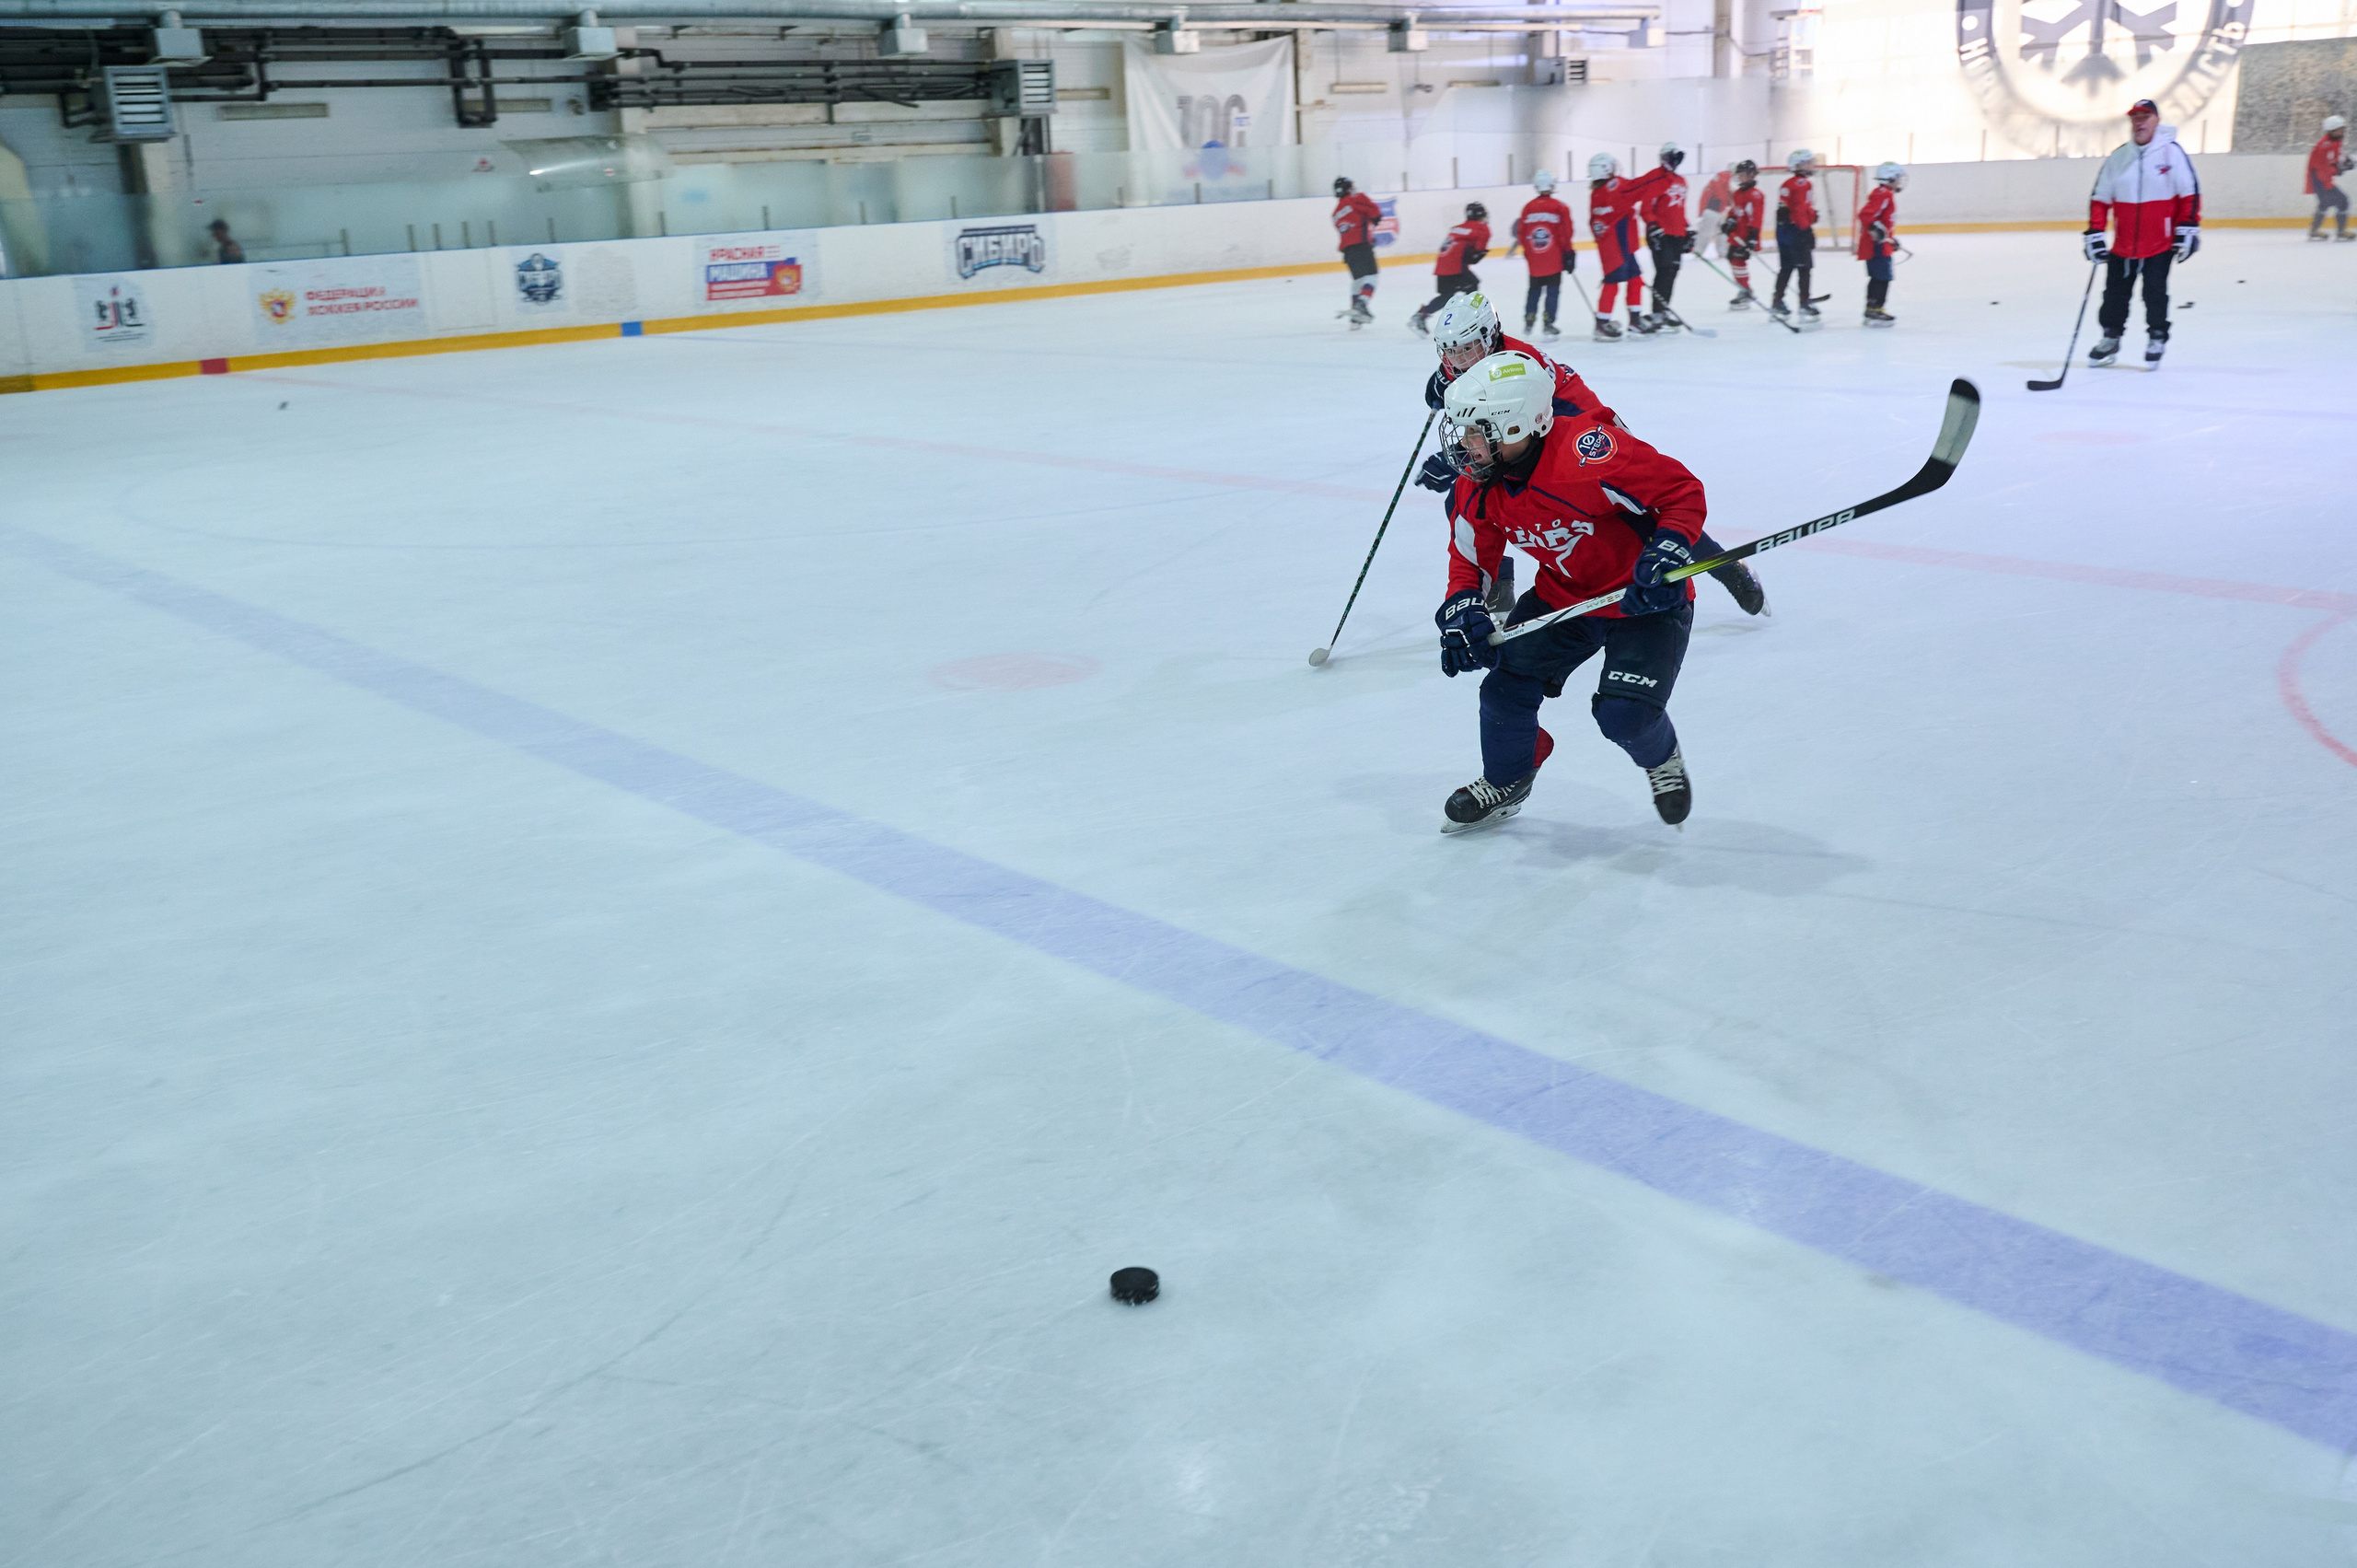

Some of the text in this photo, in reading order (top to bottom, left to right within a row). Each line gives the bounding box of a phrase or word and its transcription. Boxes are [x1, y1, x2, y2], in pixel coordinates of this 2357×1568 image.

[710, 246, 764, 261] КРАСНАЯ
[958, 233, 1045, 274] СИБИРЬ
[709, 262, 768, 282] МАШИНА
[305, 286, 386, 301] ФЕДЕРАЦИЯ
[364, 298, 419, 311] РОССИИ
[1444, 313, 1453, 326] 2
[1503, 366, 1524, 375] Airlines
[1579, 435, 1596, 449] 10
[1589, 434, 1605, 457] STEPS
[1756, 508, 1856, 553] BAUER
[1445, 597, 1485, 621] BAU
[1608, 670, 1658, 688] CCM
